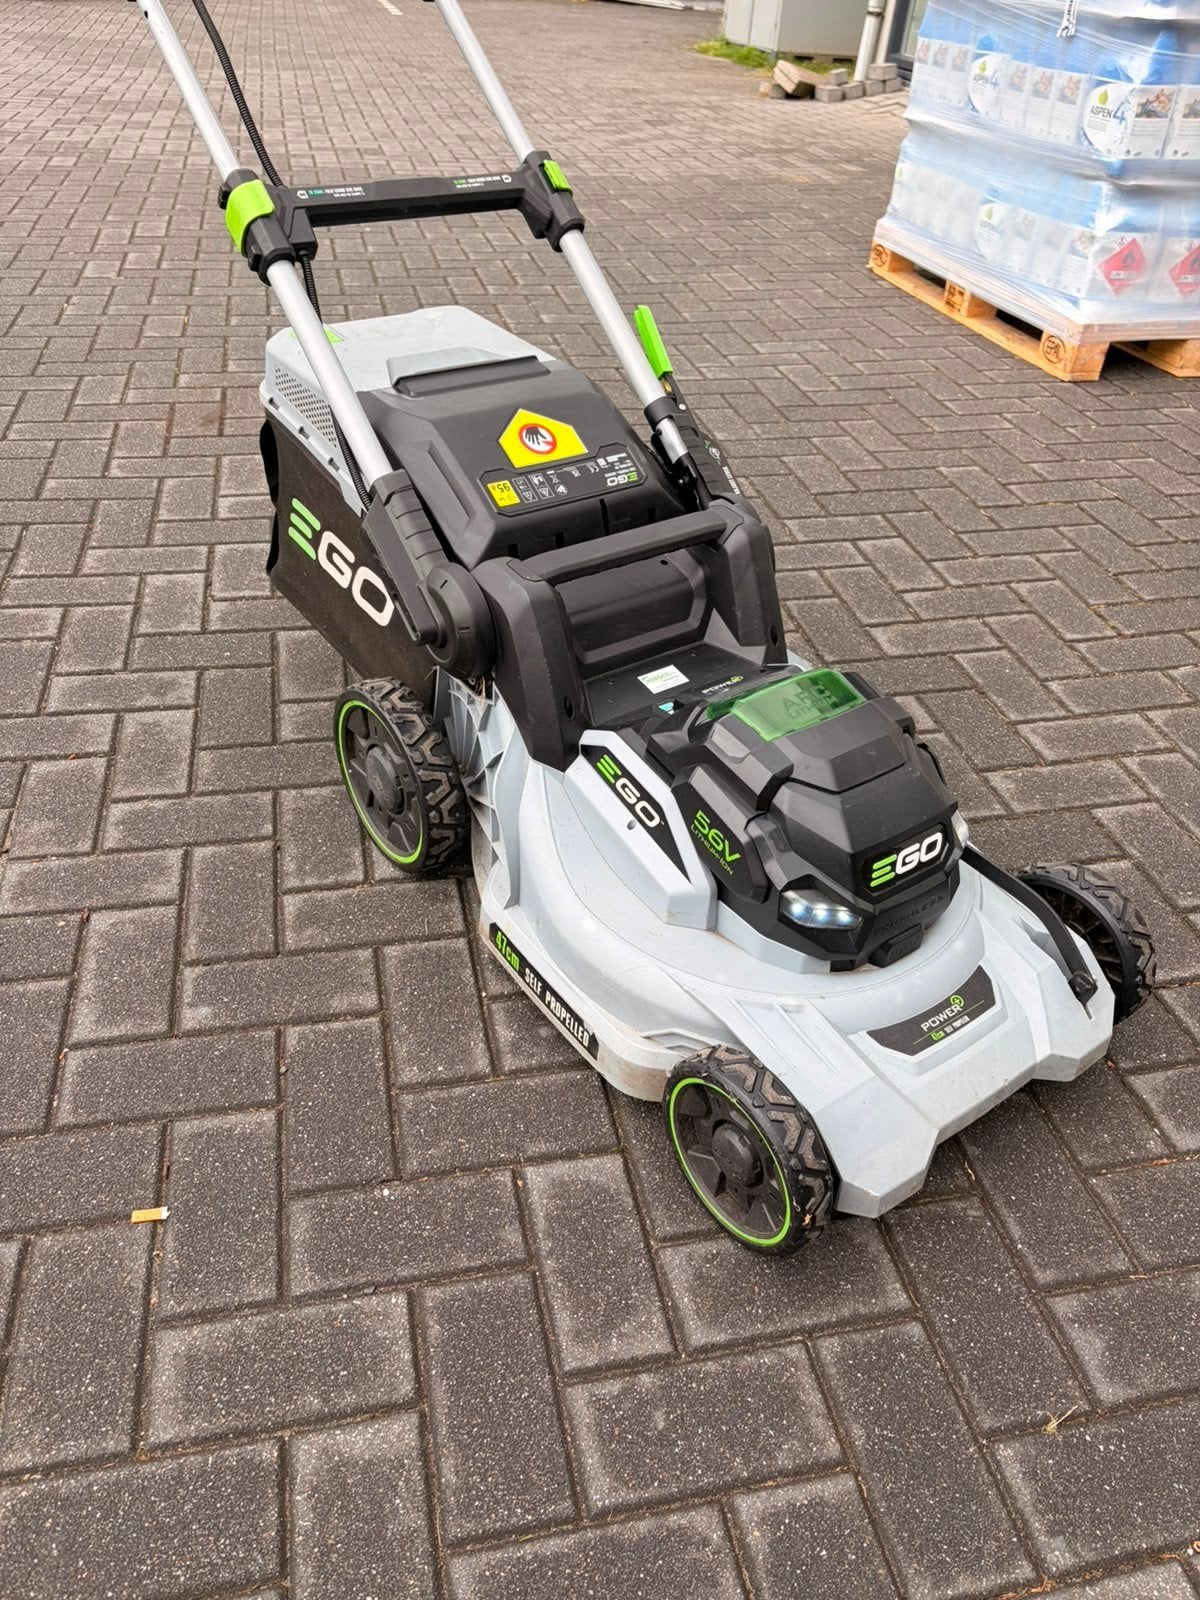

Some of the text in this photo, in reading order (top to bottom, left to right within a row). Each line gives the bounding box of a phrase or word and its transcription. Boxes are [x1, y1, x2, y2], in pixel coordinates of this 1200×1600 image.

[1090, 105, 1113, 118] ASPEN
[1113, 101, 1126, 125] 4
[606, 471, 639, 487] EGO
[288, 497, 395, 627] EGO
[596, 753, 661, 828] EGO
[690, 823, 734, 876] LITHIUM-ION
[694, 809, 741, 862] 56V
[870, 832, 943, 888] EGO
[495, 930, 590, 1048] 47cm SELF PROPELLED
